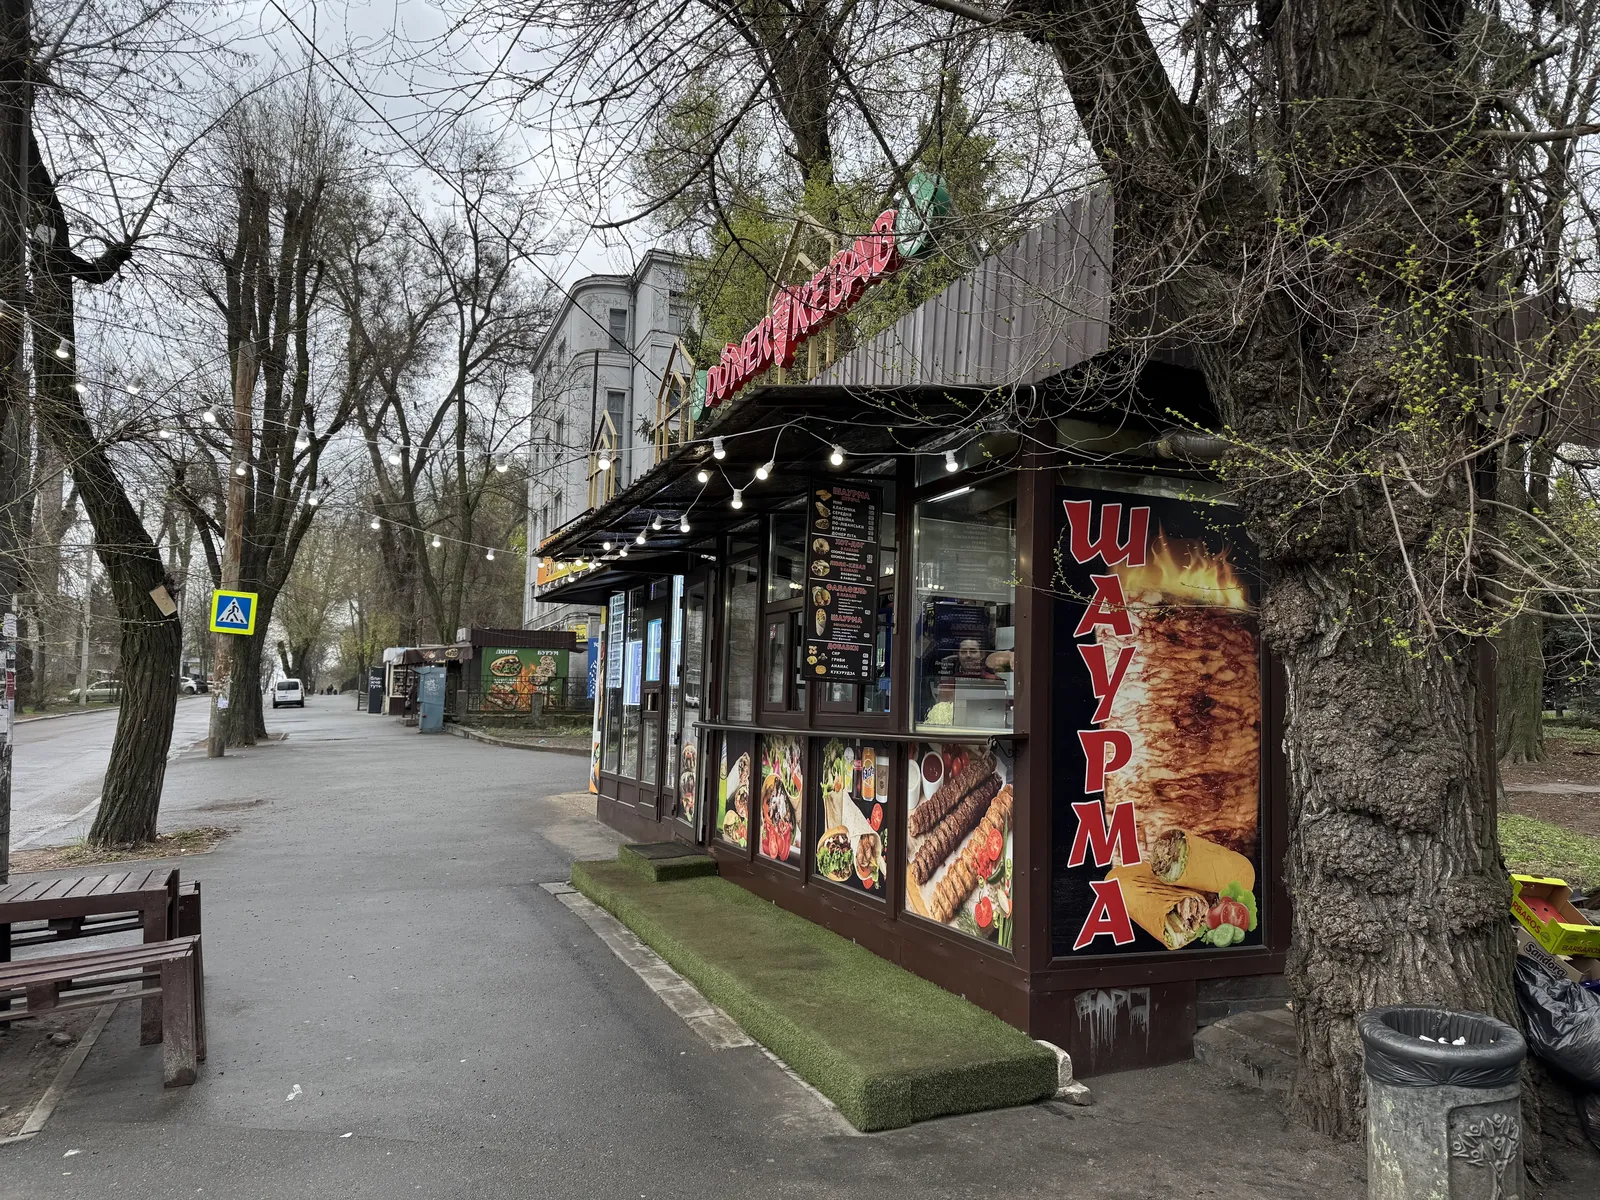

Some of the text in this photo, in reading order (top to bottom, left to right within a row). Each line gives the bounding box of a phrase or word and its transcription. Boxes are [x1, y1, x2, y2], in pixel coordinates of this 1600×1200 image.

[791, 208, 900, 342] KEBAB
[830, 613, 863, 624] ШАУРМА
[1063, 498, 1152, 952] ШАУРМА
[1512, 901, 1541, 934] RBAROS
